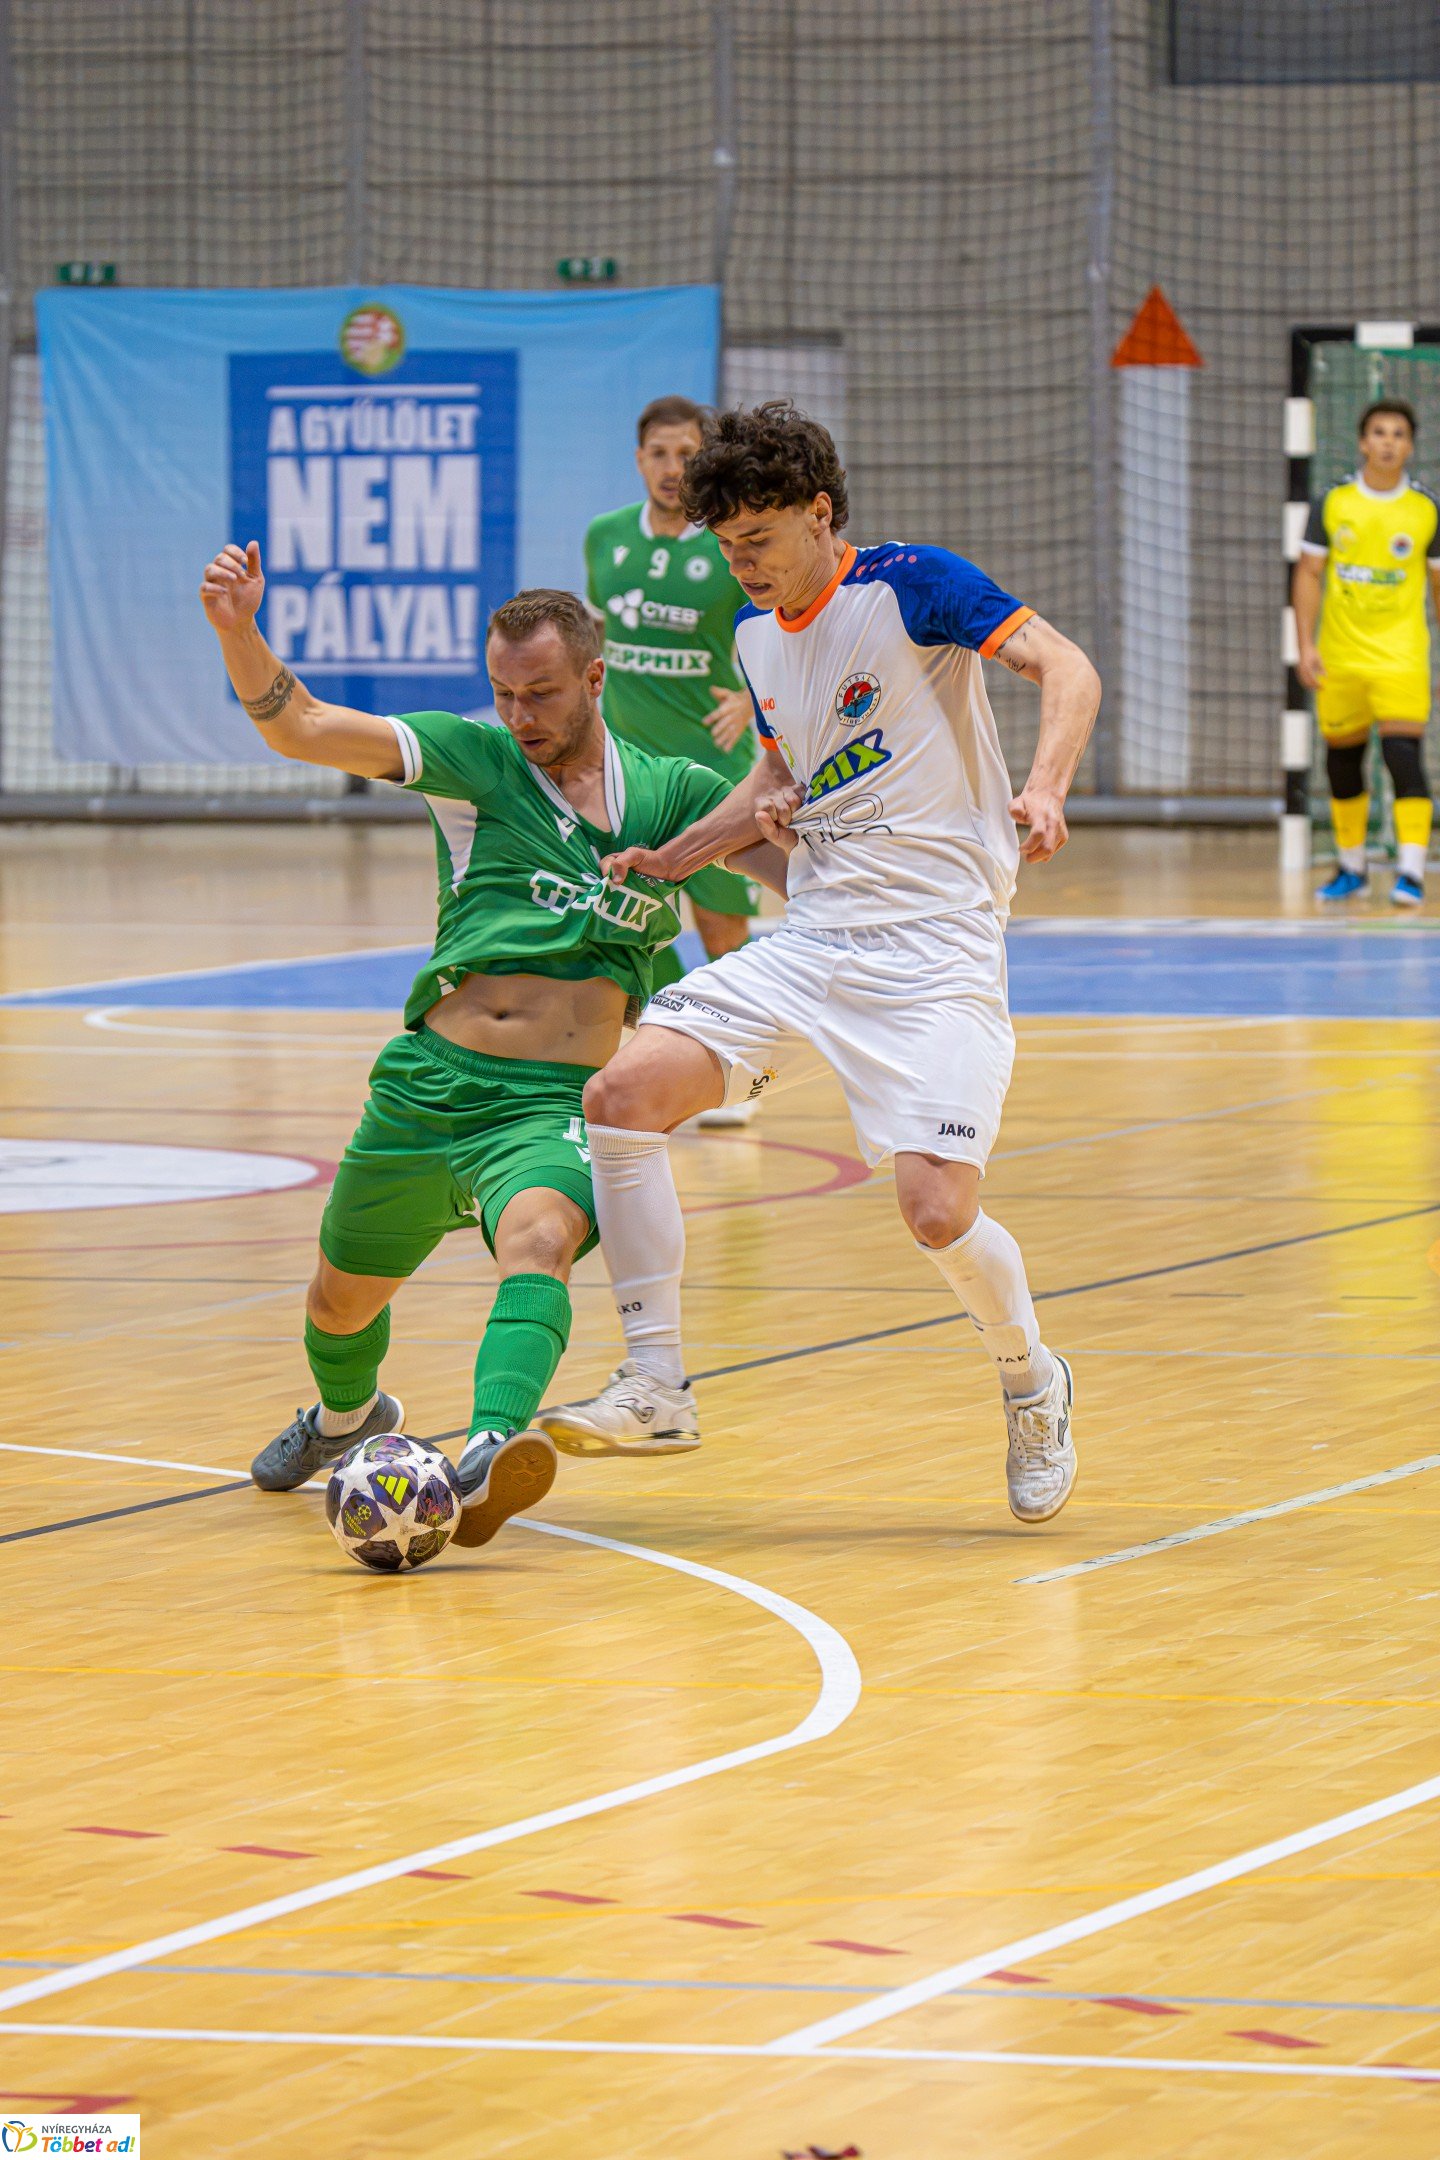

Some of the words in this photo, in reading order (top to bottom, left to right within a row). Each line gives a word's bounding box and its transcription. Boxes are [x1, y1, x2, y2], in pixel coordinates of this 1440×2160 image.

[268, 405, 298, 451] A
[301, 398, 480, 451] GYŰLÖLET
[267, 454, 482, 571] NEM
[647, 547, 670, 579] 9
[267, 570, 479, 660] PÁLYA!
[938, 1123, 976, 1139] JAKO
